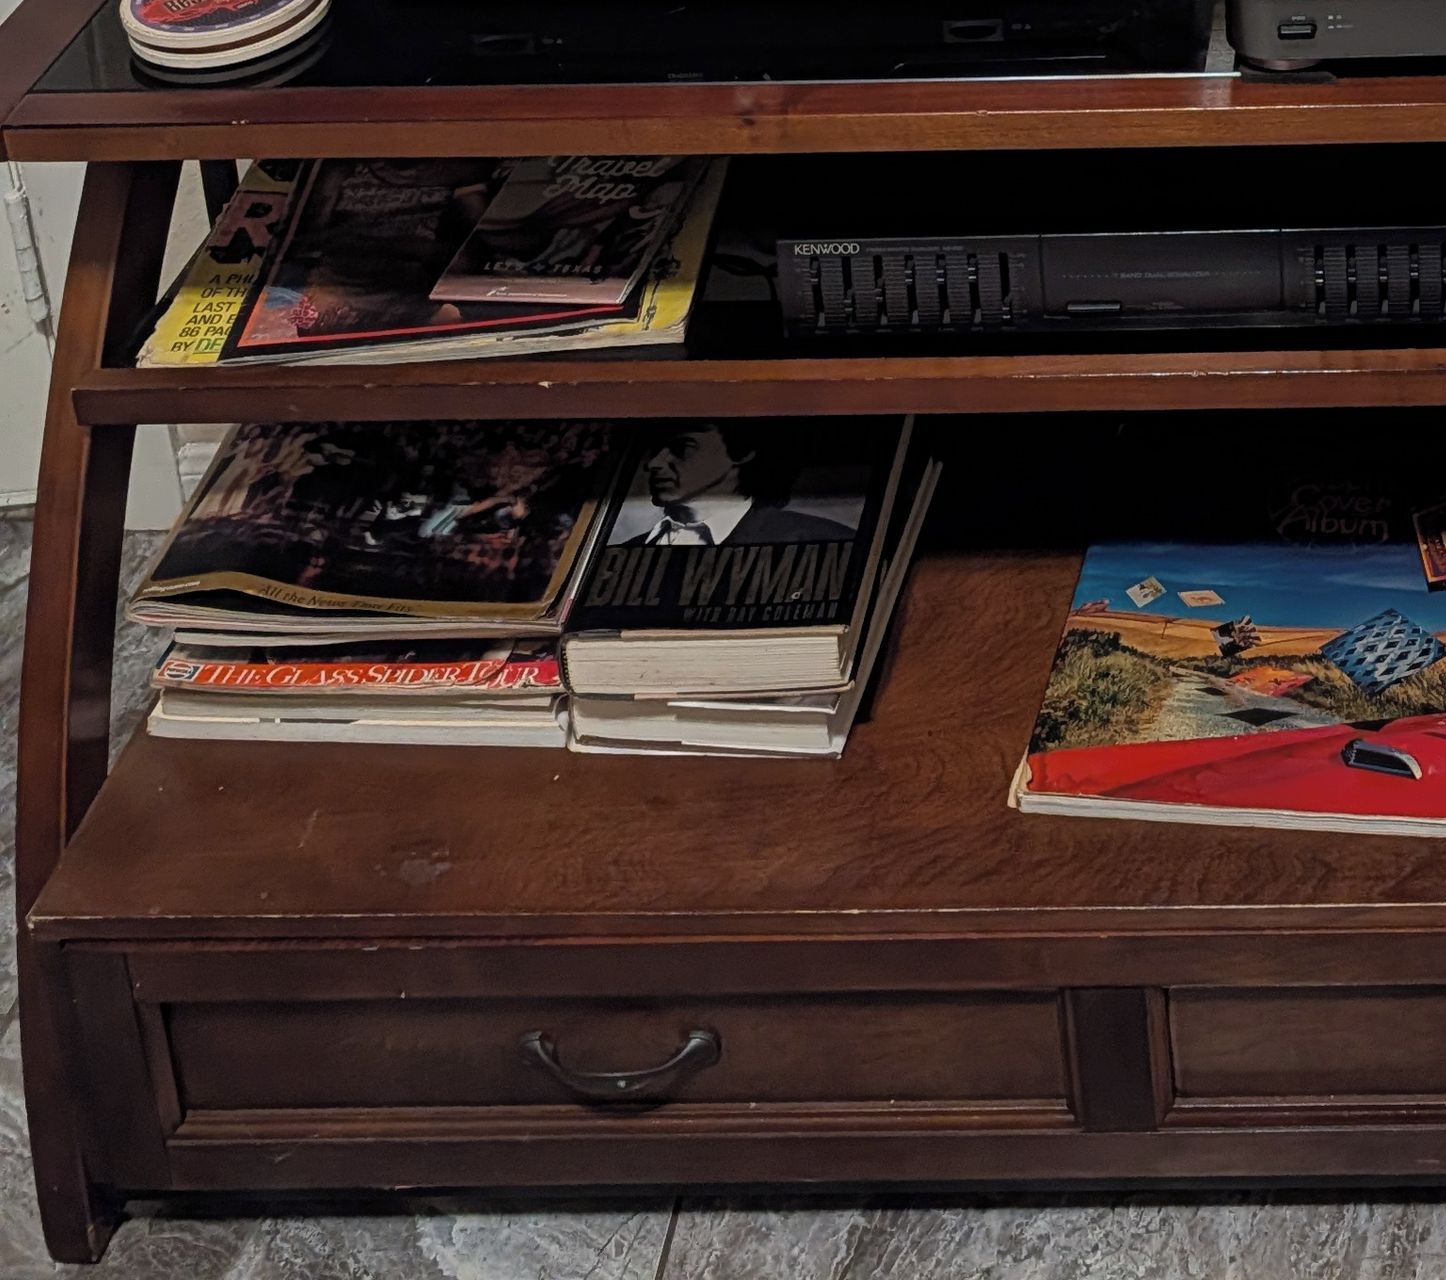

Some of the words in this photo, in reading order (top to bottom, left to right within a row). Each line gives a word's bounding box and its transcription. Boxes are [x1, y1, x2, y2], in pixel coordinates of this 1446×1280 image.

[543, 174, 639, 203] Map
[794, 243, 861, 256] KENWOOD
[208, 273, 221, 285] A
[201, 286, 224, 298] OF
[193, 301, 236, 314] LAST
[186, 313, 223, 326] AND
[171, 341, 190, 353] BY
[583, 545, 673, 608] BILL
[677, 540, 855, 607] WYMAN
[261, 583, 282, 597] All
[282, 590, 303, 605] the
[306, 595, 345, 608] News
[204, 664, 266, 685] THE
[266, 663, 362, 687] GLASS
[366, 661, 462, 686] SPIDER
